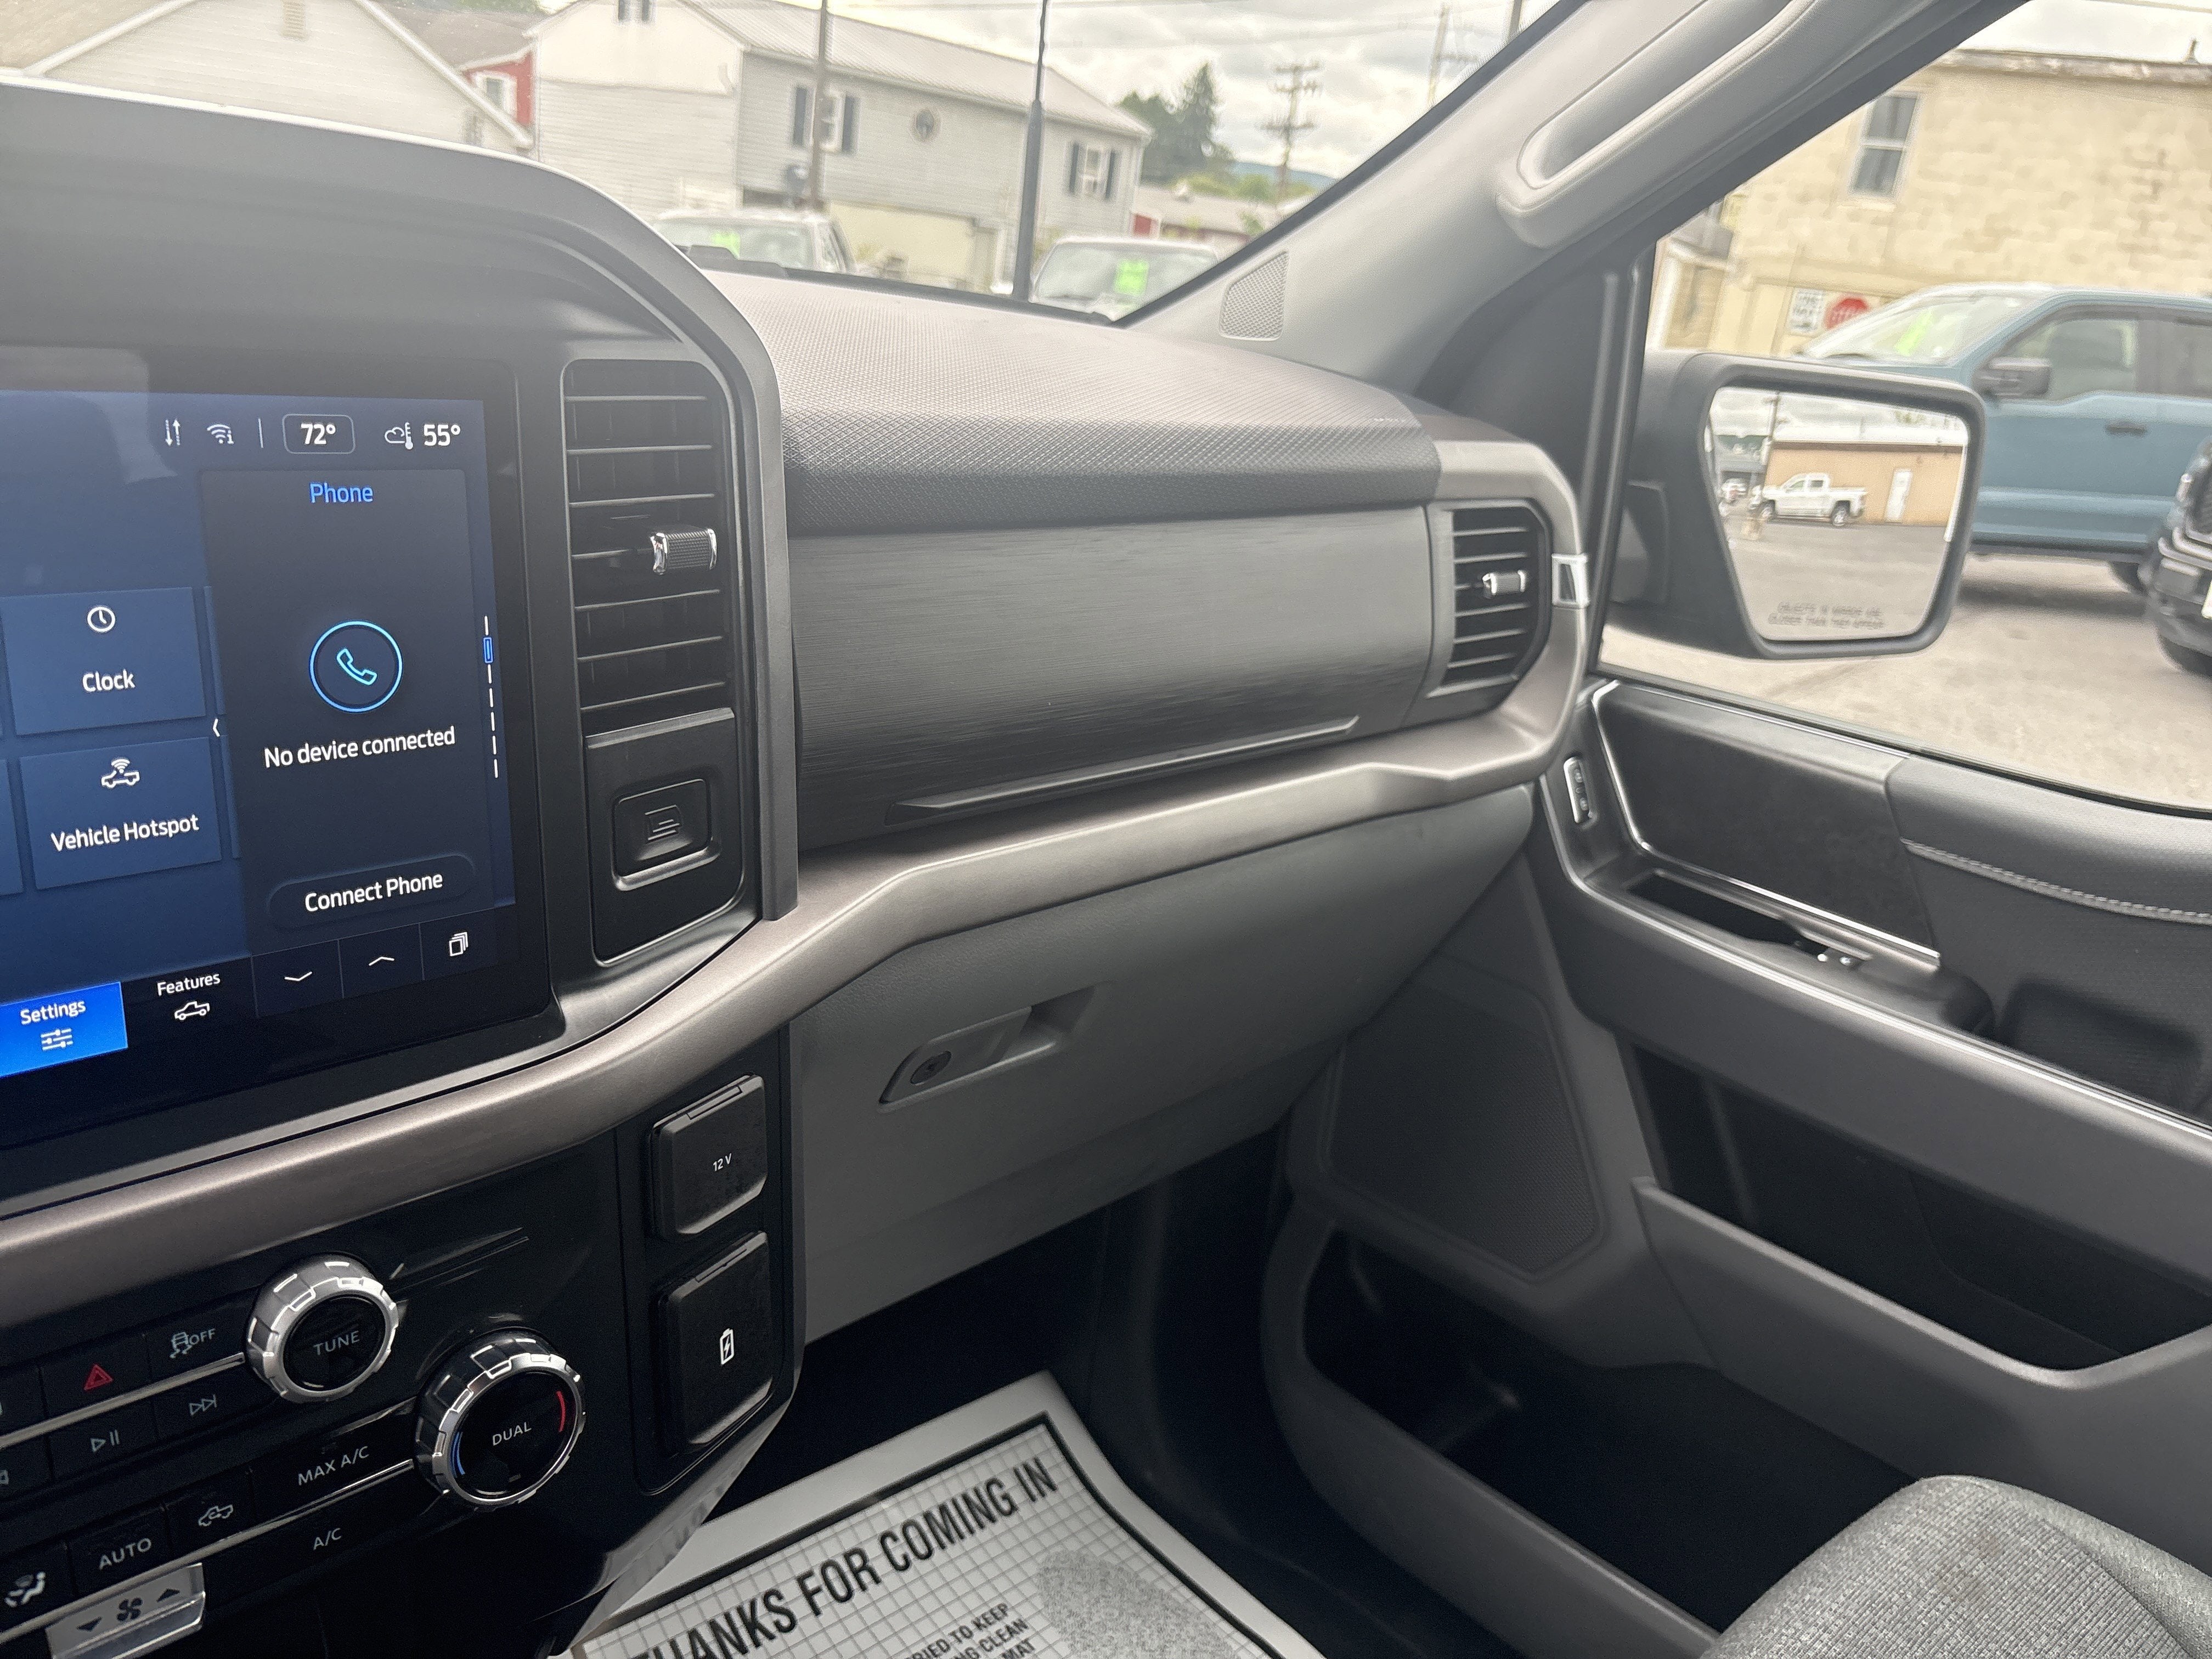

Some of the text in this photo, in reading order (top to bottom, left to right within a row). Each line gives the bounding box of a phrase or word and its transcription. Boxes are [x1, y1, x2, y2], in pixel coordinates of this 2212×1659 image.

[301, 422, 336, 445] 72°
[423, 423, 461, 447] 55°
[309, 482, 374, 504] Phone
[82, 670, 136, 692] Clock
[264, 725, 456, 769] No device connected
[50, 814, 200, 852] Vehicle Hotspot
[304, 872, 443, 913] Connect Phone
[156, 972, 221, 996] Features
[20, 998, 87, 1027] Settings
[712, 1153, 732, 1172] 12 V
[188, 1327, 216, 1347] OFF
[313, 1329, 361, 1356] TUNE
[491, 1420, 533, 1446] DUAL
[297, 1445, 370, 1486] MAX A/C
[312, 1528, 342, 1551] A/C
[98, 1537, 153, 1570] AUTO
[631, 1457, 1059, 1659] ANKS FOR COMING IN
[948, 1625, 974, 1645] TO
[971, 1602, 1009, 1631] KEEP
[978, 1618, 1030, 1652] CLEAN
